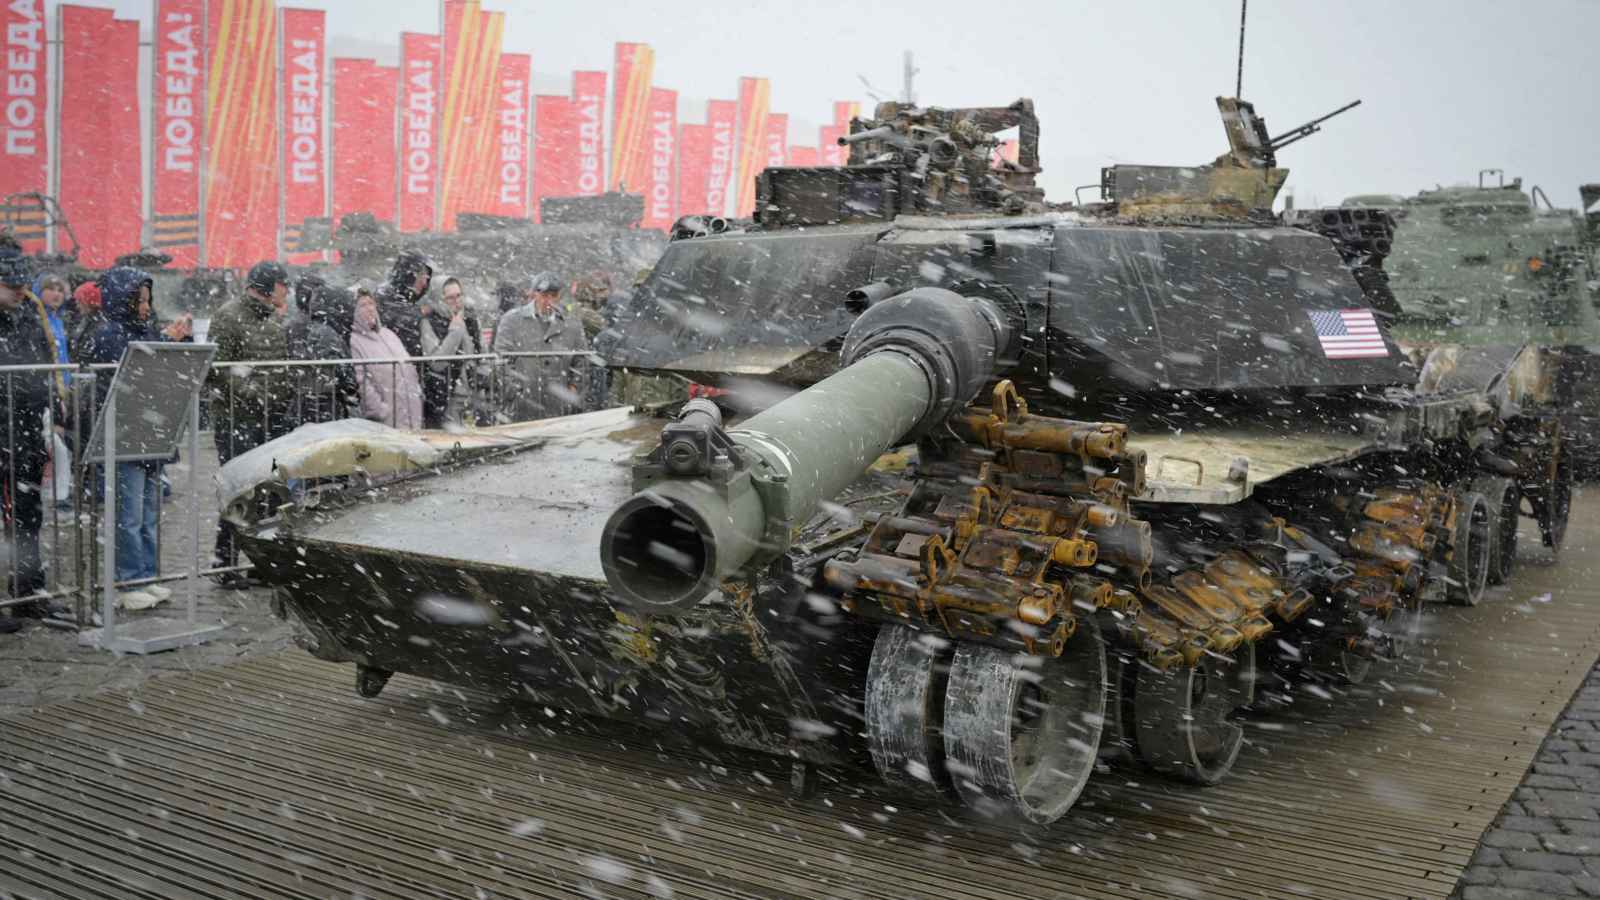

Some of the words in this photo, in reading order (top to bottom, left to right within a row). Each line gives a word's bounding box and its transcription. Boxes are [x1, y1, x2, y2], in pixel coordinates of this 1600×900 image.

[165, 13, 198, 172] ПОБЕДА!
[292, 39, 318, 183] ПОБЕДА!
[408, 60, 434, 193] ПОБЕДА!
[501, 80, 524, 204] ПОБЕДА!
[653, 111, 673, 218] ПОБЕДА!
